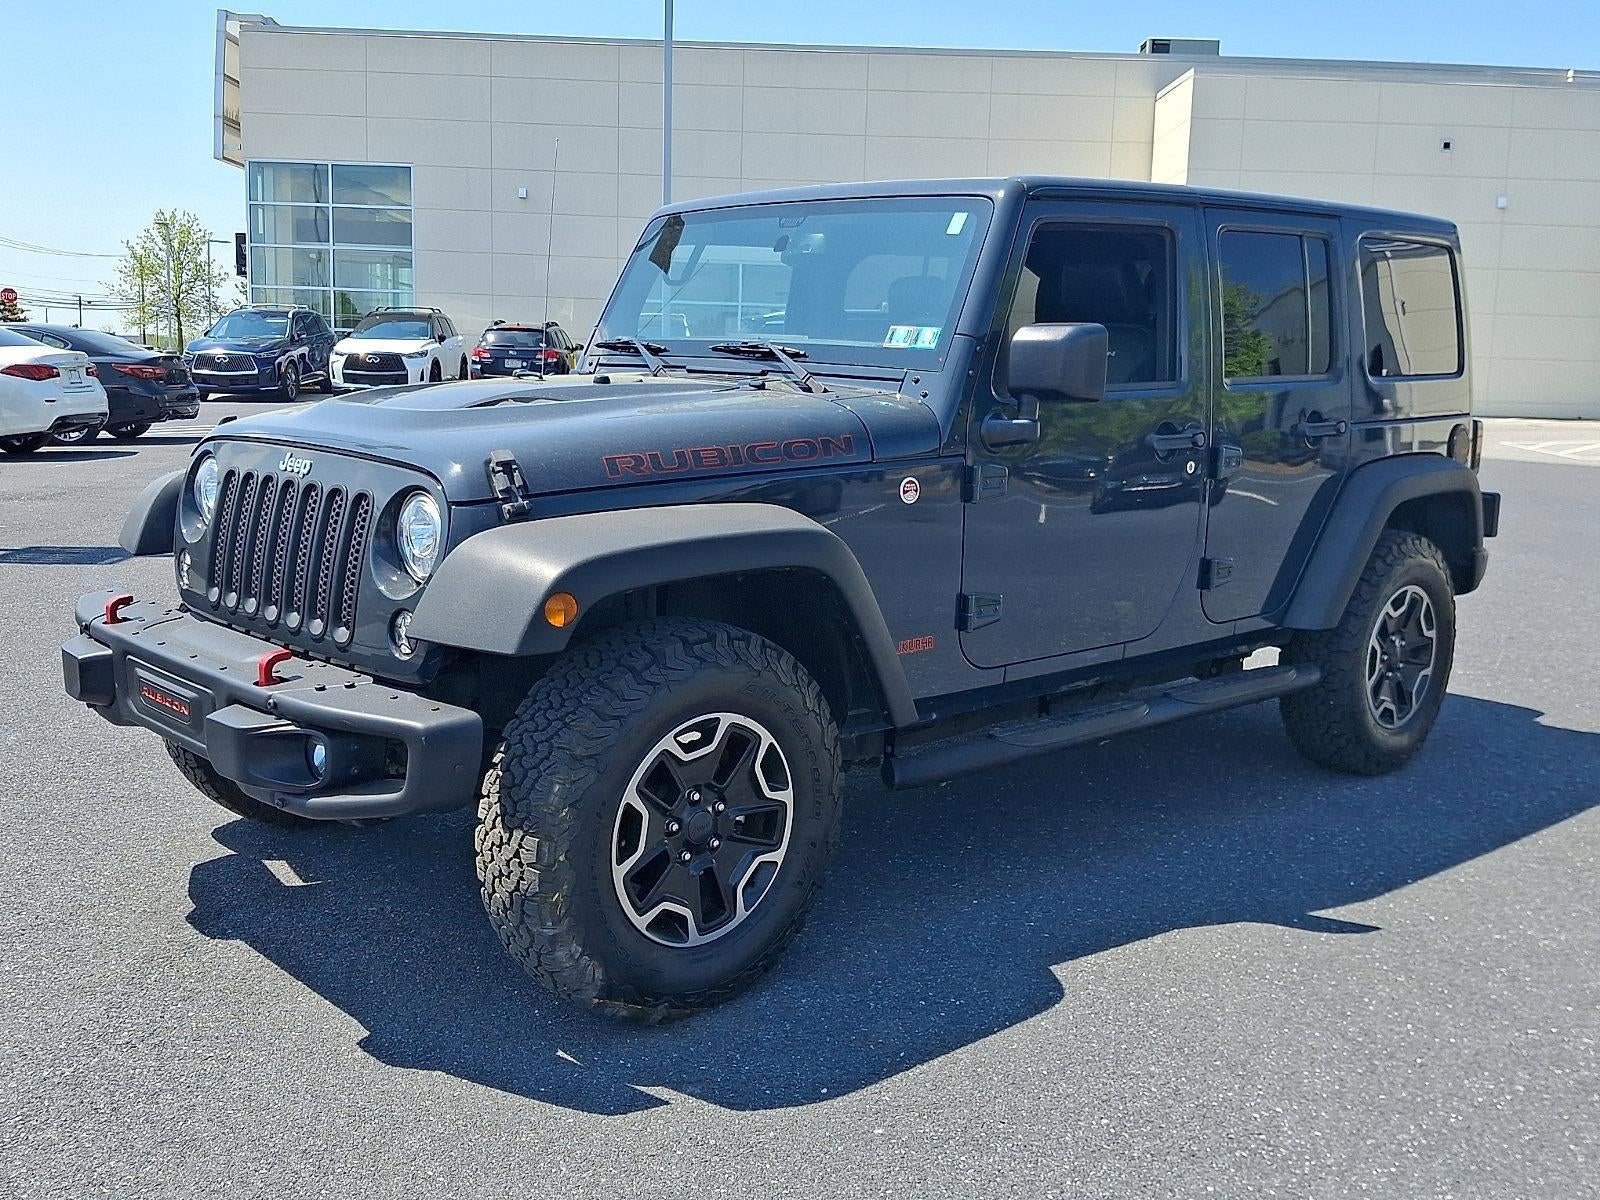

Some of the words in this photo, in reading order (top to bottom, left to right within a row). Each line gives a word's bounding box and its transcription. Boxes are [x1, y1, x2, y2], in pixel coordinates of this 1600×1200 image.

[2, 292, 17, 300] STOP
[279, 452, 314, 479] Jeep
[603, 434, 857, 478] RUBICON
[141, 686, 190, 716] RUBICON
